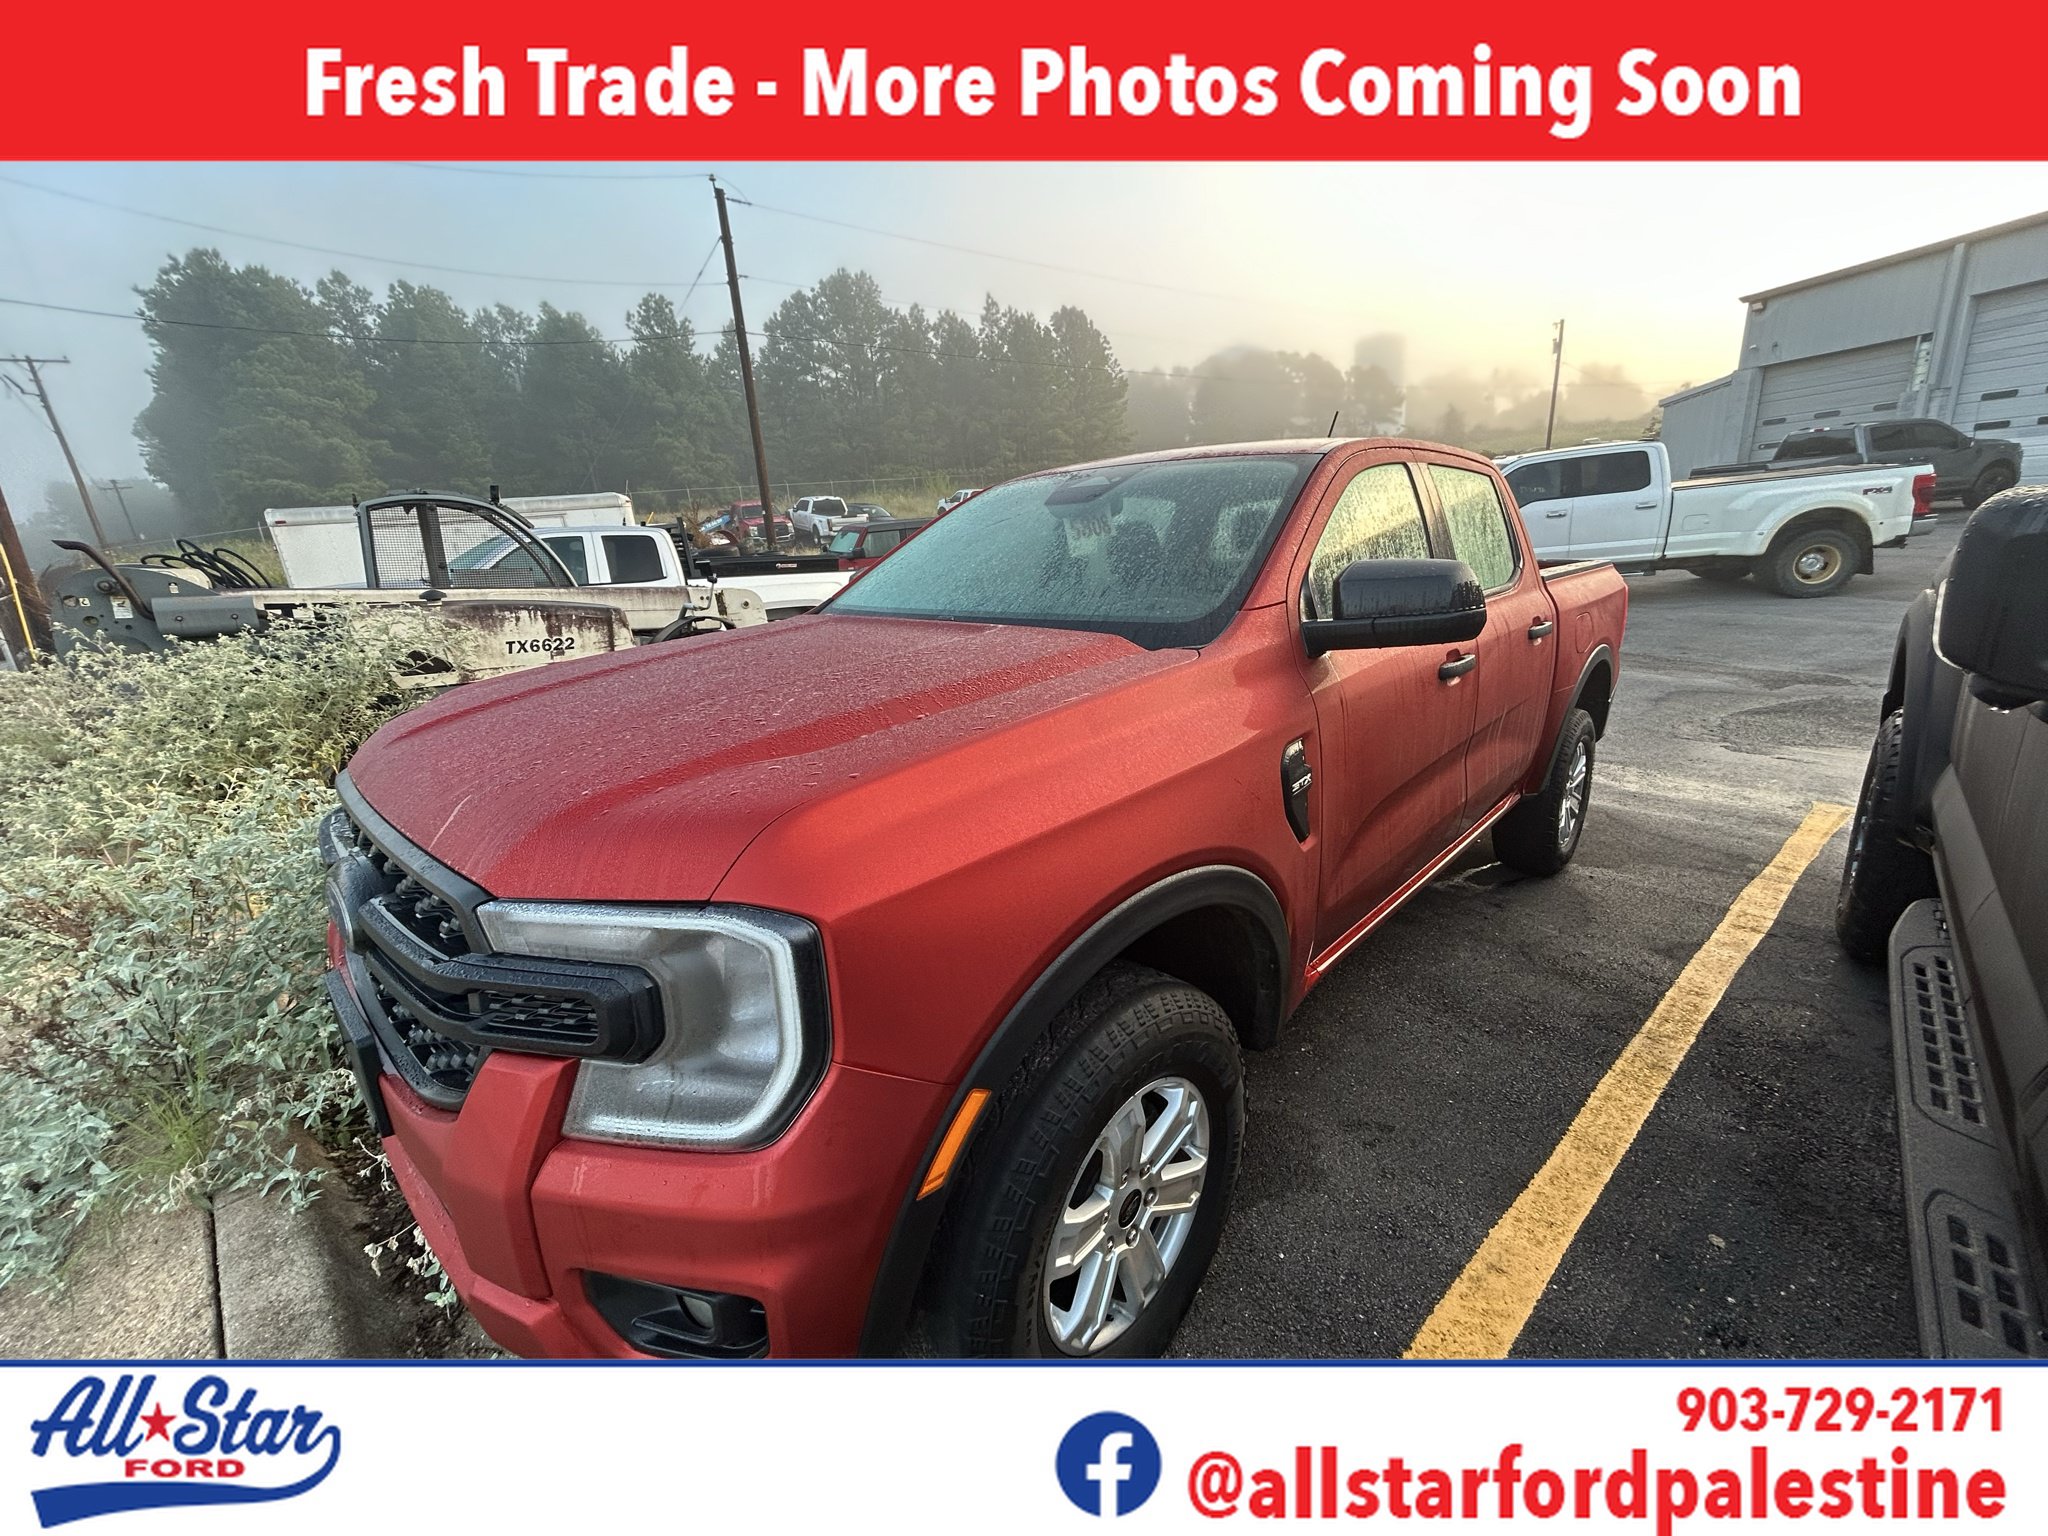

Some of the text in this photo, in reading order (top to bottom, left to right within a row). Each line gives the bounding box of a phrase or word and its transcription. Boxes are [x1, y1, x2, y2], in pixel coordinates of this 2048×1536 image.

[1862, 486, 1893, 496] FX4
[505, 637, 575, 654] TX6622
[1292, 773, 1312, 792] STX
